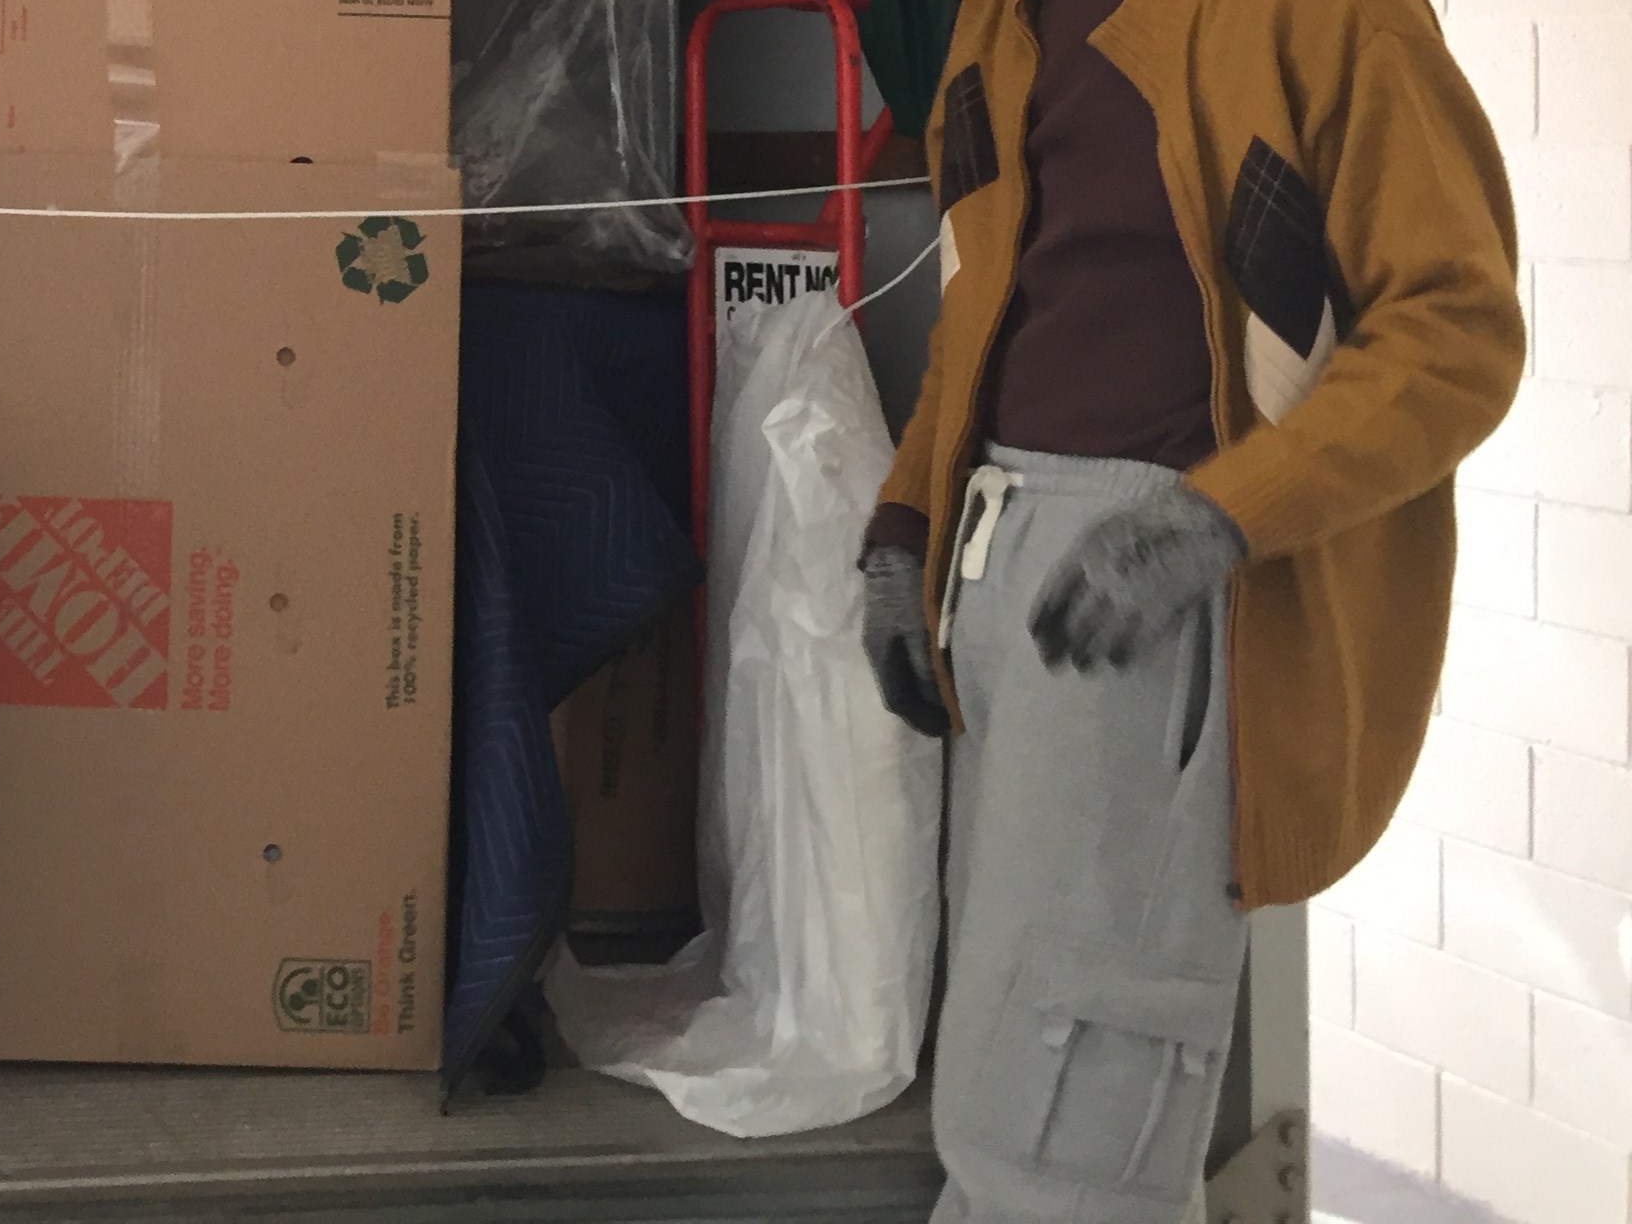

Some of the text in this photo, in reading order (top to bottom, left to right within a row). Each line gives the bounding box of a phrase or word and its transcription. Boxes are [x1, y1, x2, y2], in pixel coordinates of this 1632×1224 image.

[724, 261, 841, 304] RENT NO
[44, 495, 170, 629] DEPOT
[181, 547, 215, 710] More saving.
[209, 559, 240, 712] More doing.
[386, 513, 404, 709] This box is made from
[401, 512, 424, 706] 100% recycled paper.
[325, 965, 350, 1027] ECO
[396, 888, 417, 1034] Think Green.
